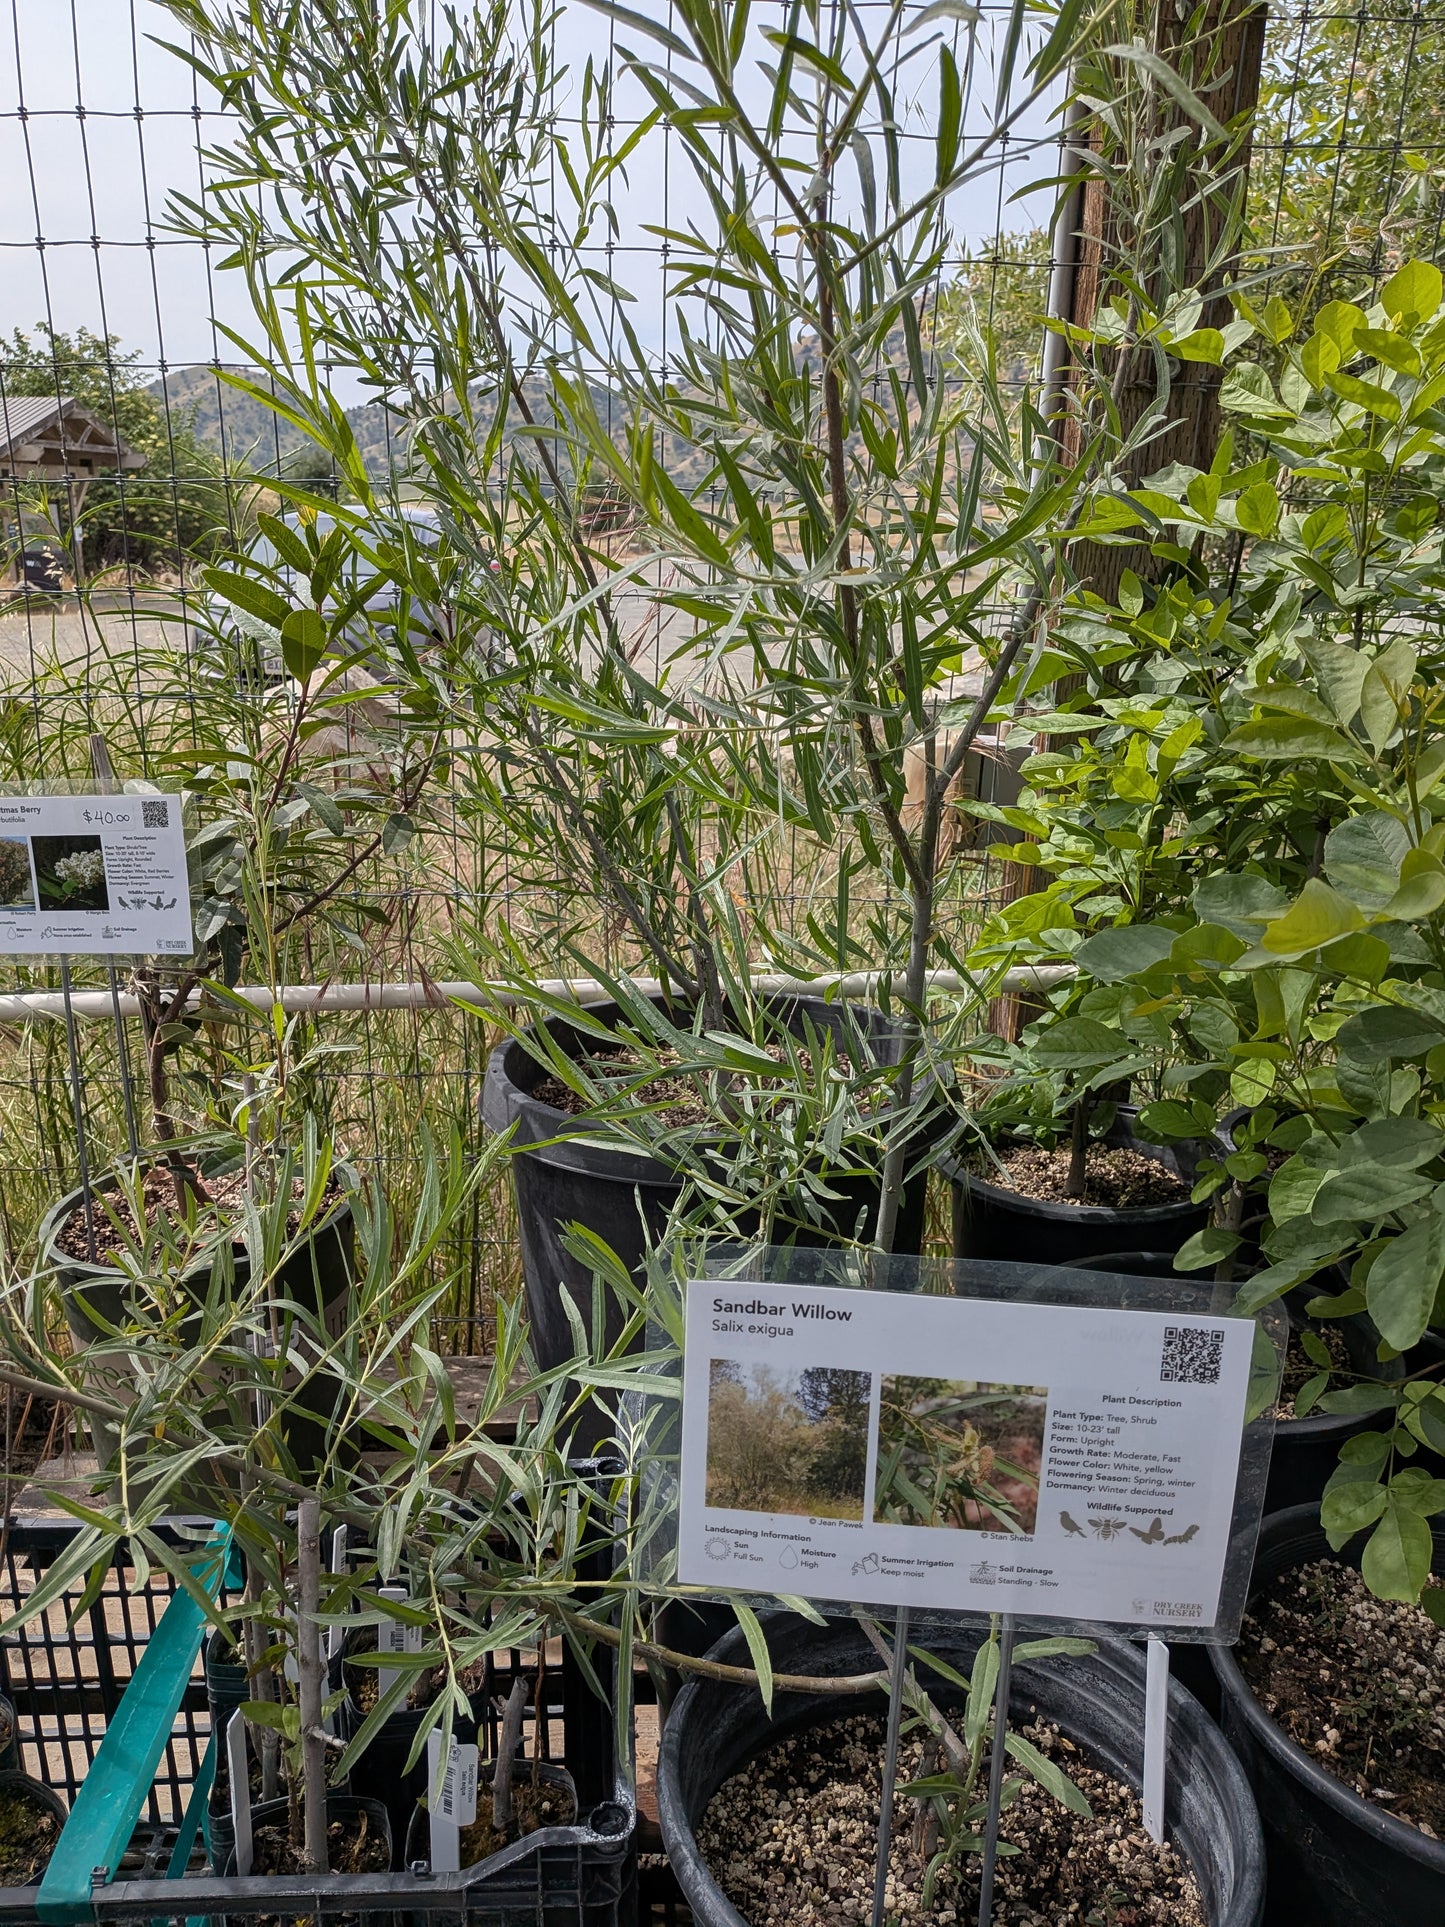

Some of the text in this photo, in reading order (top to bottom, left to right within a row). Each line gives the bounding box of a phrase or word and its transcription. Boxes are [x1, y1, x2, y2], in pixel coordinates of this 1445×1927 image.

[20, 806, 41, 815] Berry
[713, 1299, 853, 1322] Sandbar Willow
[712, 1320, 794, 1337] Salix exigua
[1102, 1395, 1182, 1408] Plant Description
[1053, 1410, 1157, 1425] Plant Type: Tree, Shrub
[1051, 1422, 1121, 1435] Size: 10-23' tall
[1051, 1434, 1115, 1447] Form: Upright
[1050, 1446, 1181, 1463] Growth Rate: Moderate, Fast
[1048, 1457, 1173, 1475] Flower Color: White, yellow
[1047, 1469, 1196, 1488] Flowering Season: Spring, winter
[1046, 1481, 1176, 1498] Dormancy: Winter deciduous
[1087, 1502, 1174, 1516] Wildlife Supported
[818, 1519, 836, 1527] Jean
[838, 1520, 864, 1529] Pawek
[705, 1525, 811, 1542] Landscaping Information
[990, 1533, 1008, 1541] Stan
[1009, 1534, 1034, 1543] Shebs
[734, 1541, 749, 1549] Sun
[733, 1553, 764, 1562] Full Sun
[801, 1549, 837, 1558] Moisture
[800, 1560, 819, 1569] High
[881, 1556, 954, 1567] Summer Irrigation
[880, 1568, 925, 1578] Keep moist
[999, 1565, 1053, 1576] Soil Drainage
[998, 1577, 1033, 1587] Standing
[1174, 1602, 1204, 1610] CREEK
[1153, 1608, 1202, 1617] NURSERY
